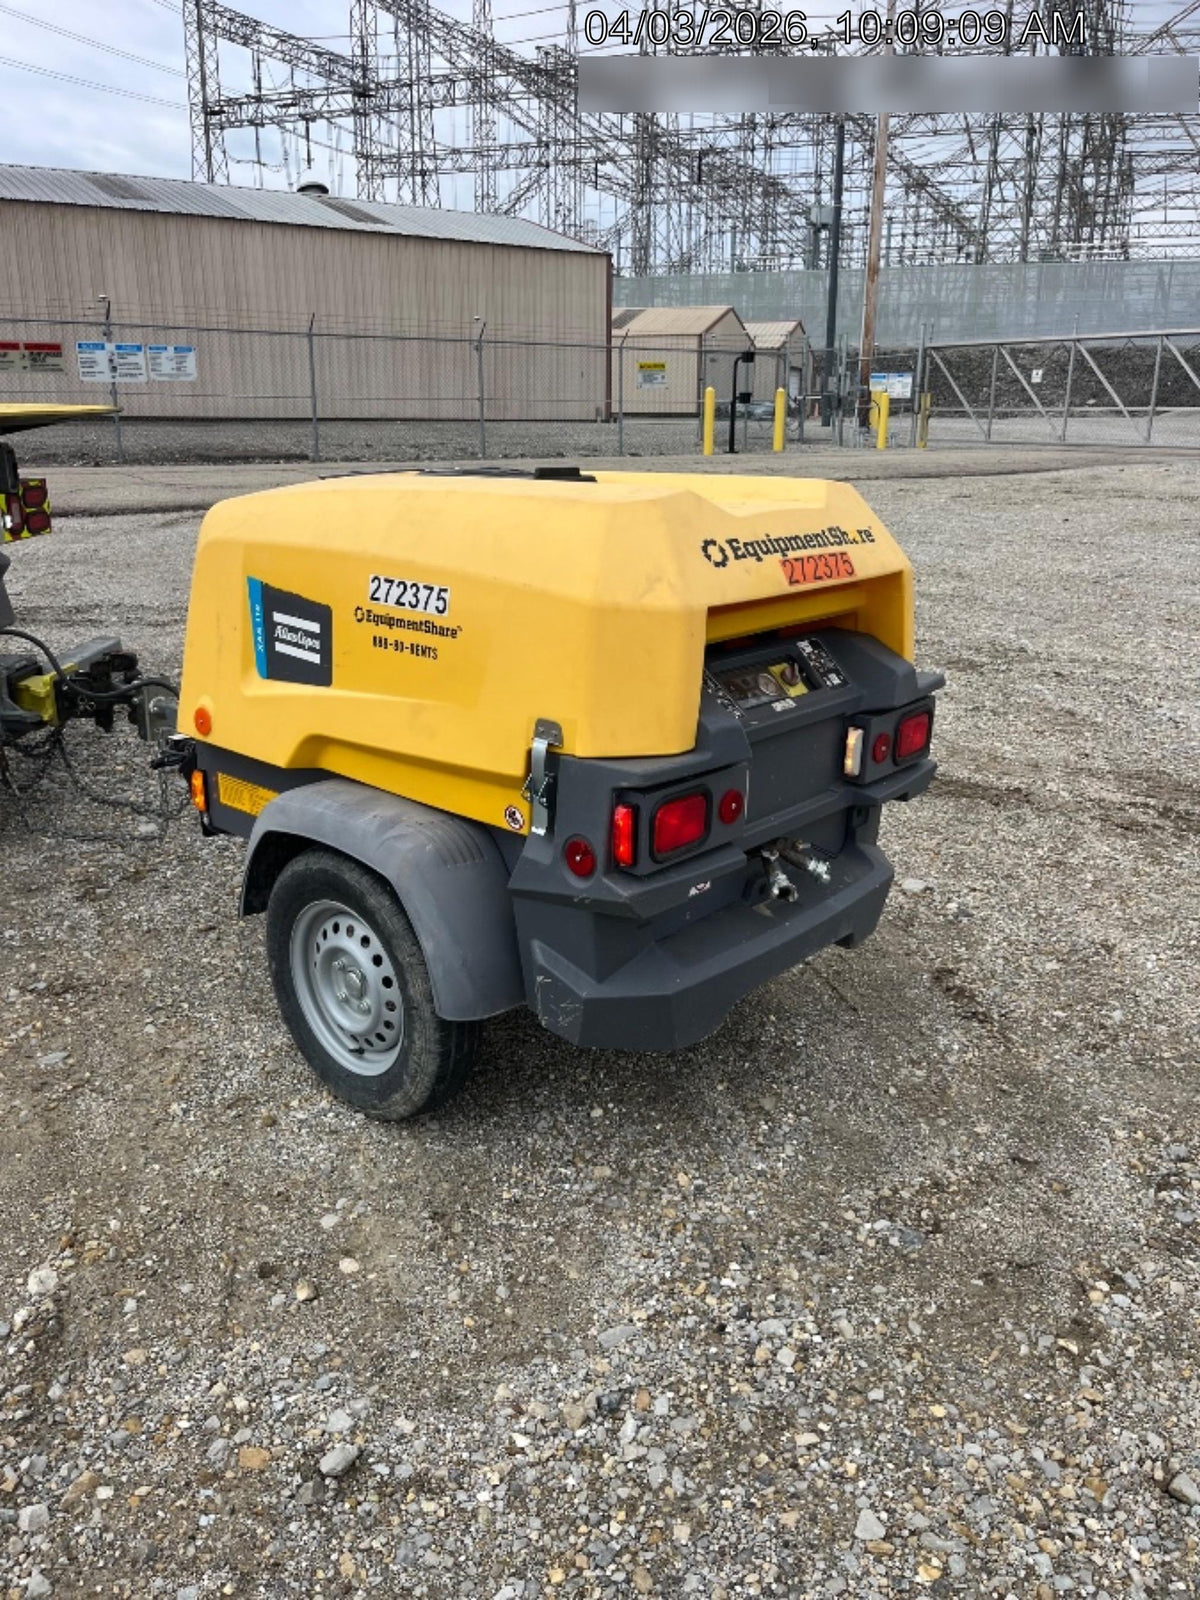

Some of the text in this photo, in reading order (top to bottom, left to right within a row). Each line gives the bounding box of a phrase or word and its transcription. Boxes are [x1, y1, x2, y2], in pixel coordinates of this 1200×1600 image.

[782, 552, 855, 586] 272375
[370, 575, 448, 614] 272375
[366, 609, 458, 639] EquipmentShare
